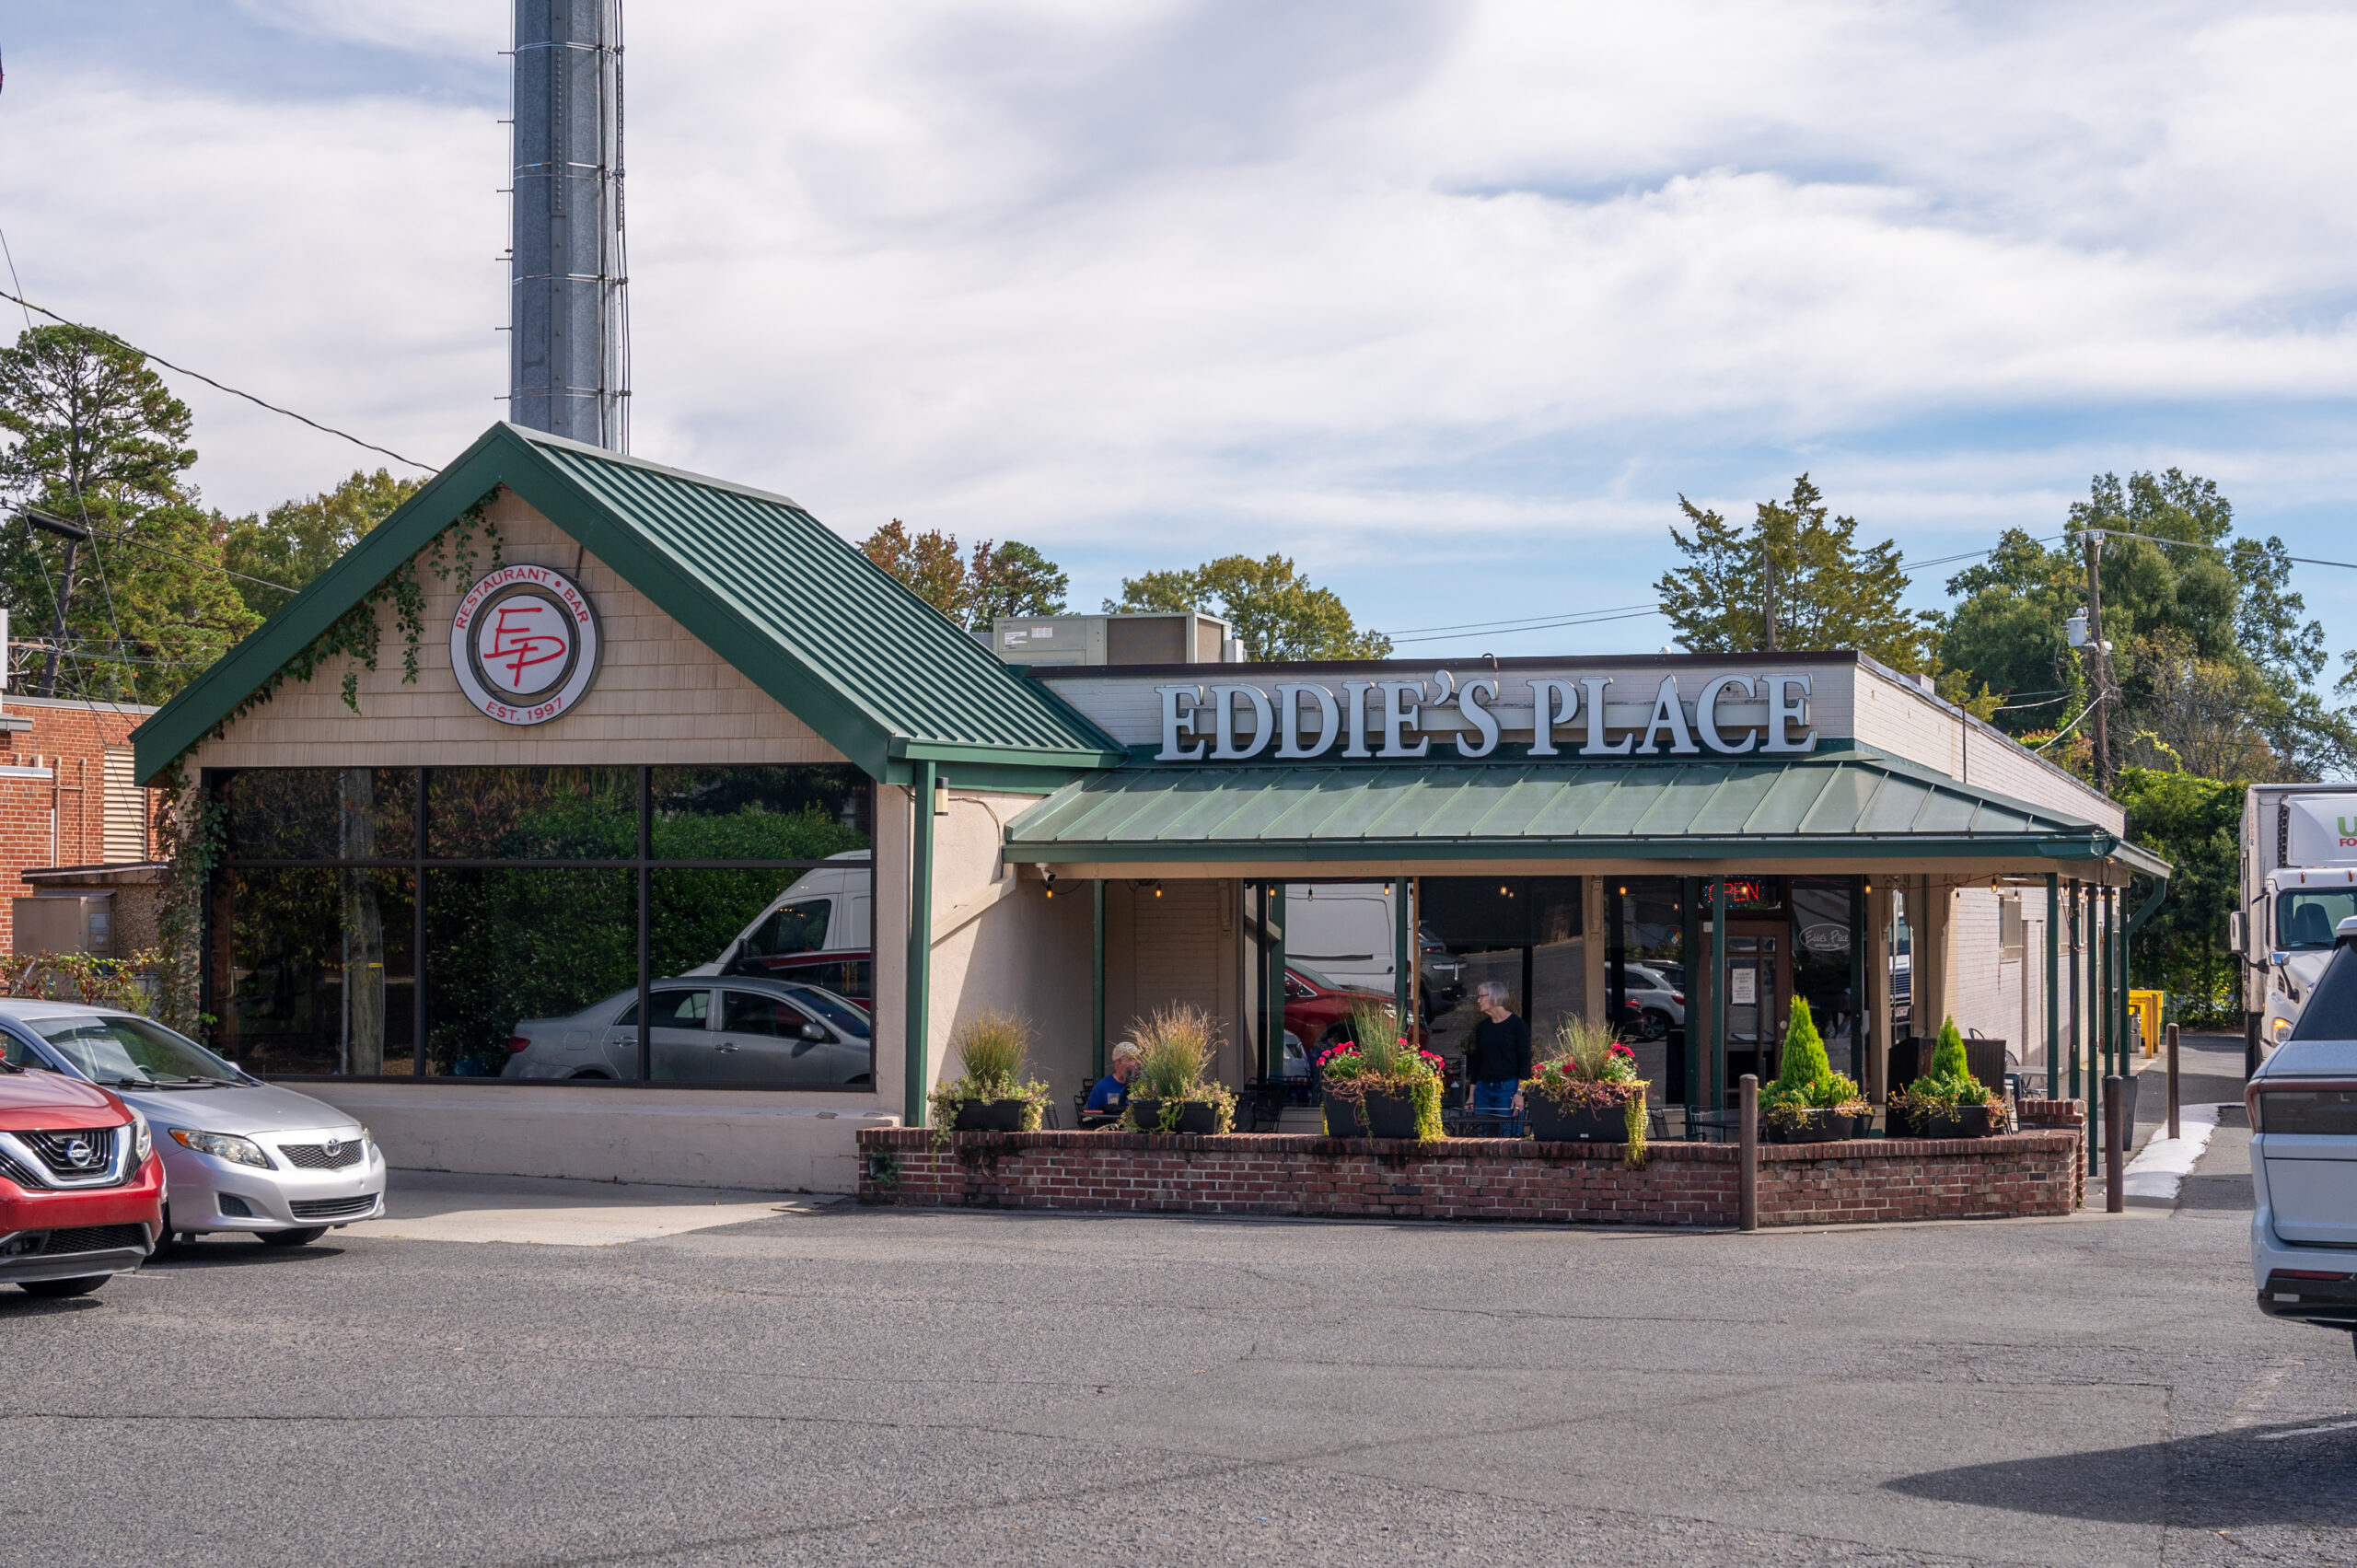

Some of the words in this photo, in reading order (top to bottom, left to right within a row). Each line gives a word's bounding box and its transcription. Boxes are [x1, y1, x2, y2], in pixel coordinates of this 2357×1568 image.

[456, 568, 550, 629] RESTAURANT
[563, 588, 589, 623] BAR
[483, 607, 566, 688] EP
[485, 701, 520, 721] EST.
[528, 697, 562, 721] 1997
[1154, 669, 1501, 761] EDDIE'S
[1527, 673, 1817, 756] PLACE
